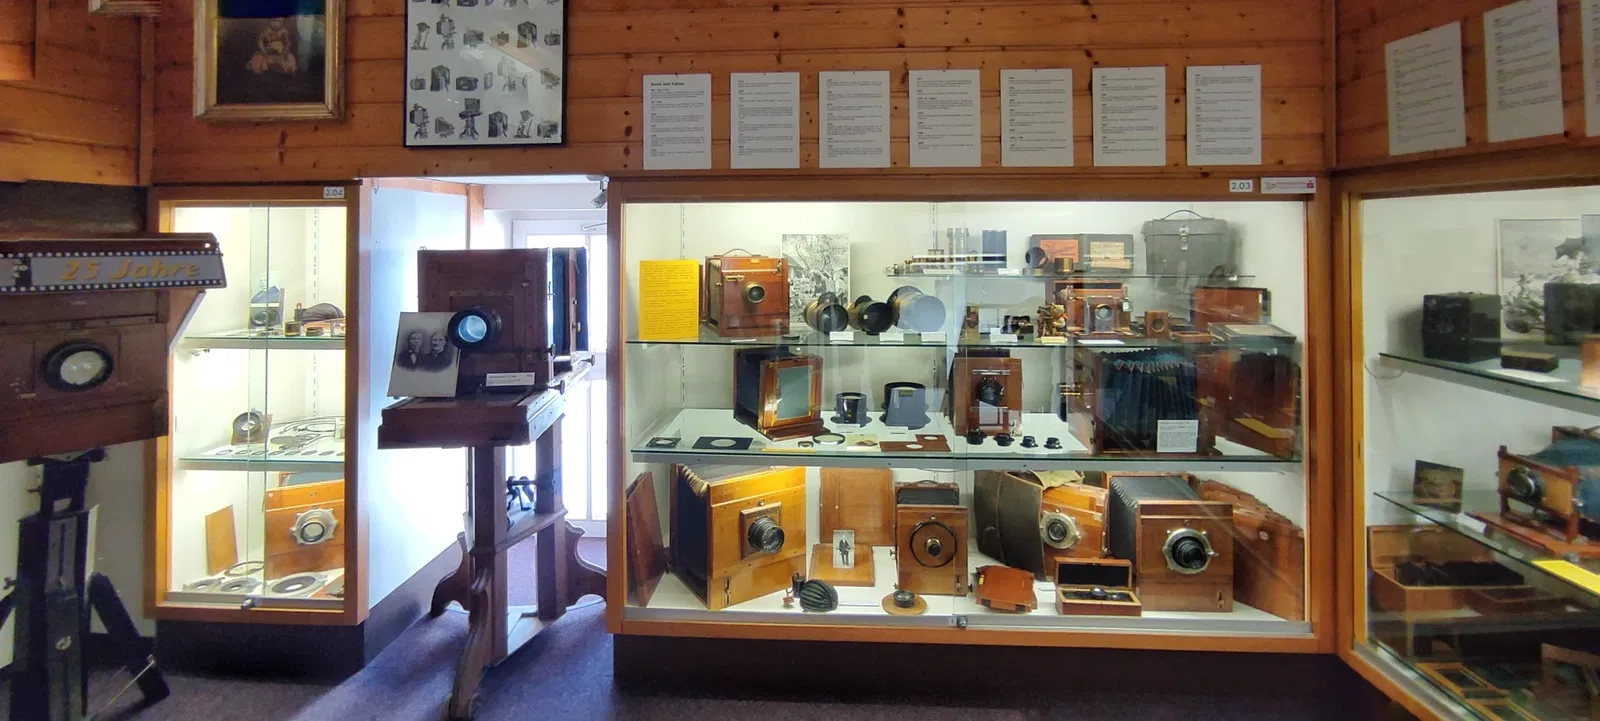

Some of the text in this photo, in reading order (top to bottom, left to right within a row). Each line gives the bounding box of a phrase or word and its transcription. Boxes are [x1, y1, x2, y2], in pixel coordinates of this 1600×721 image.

[1231, 182, 1251, 190] 2.03
[325, 188, 343, 197] 2.04
[60, 256, 200, 281] 25 Jahre
